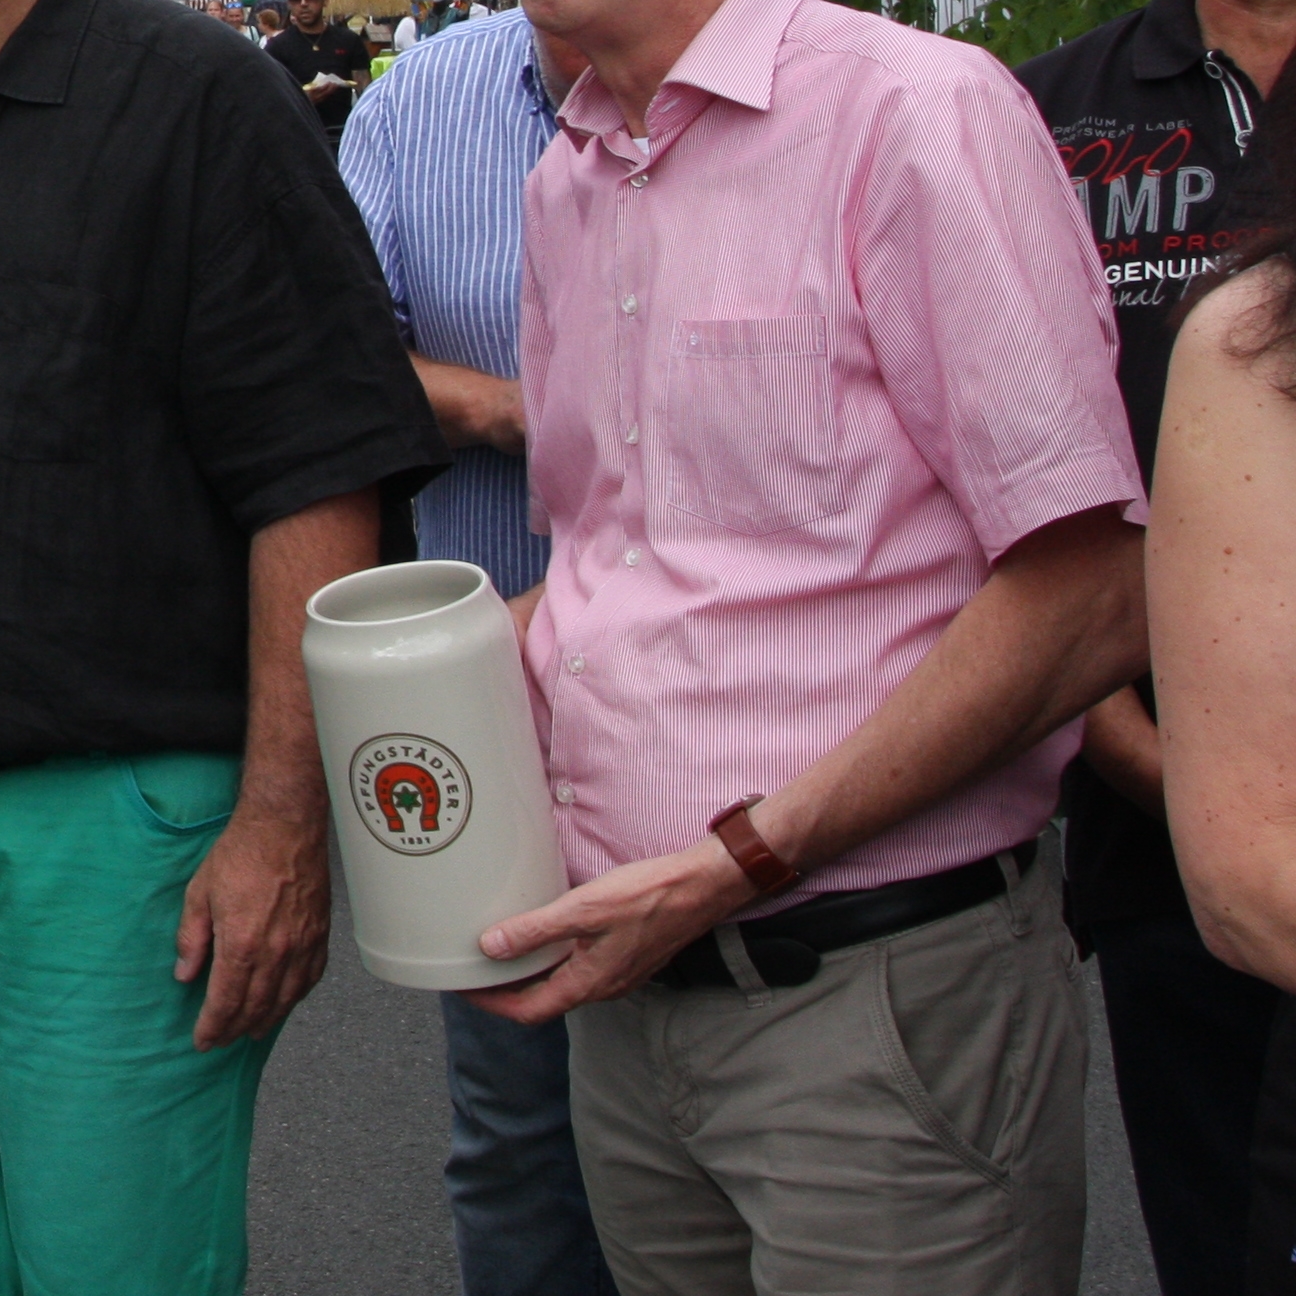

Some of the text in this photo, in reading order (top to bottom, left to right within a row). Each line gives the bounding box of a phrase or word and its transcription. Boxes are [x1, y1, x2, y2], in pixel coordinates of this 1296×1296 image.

[1145, 117, 1193, 132] LABEL
[359, 745, 460, 812] PFUNGSTÄDTER
[399, 836, 432, 845] 1831
